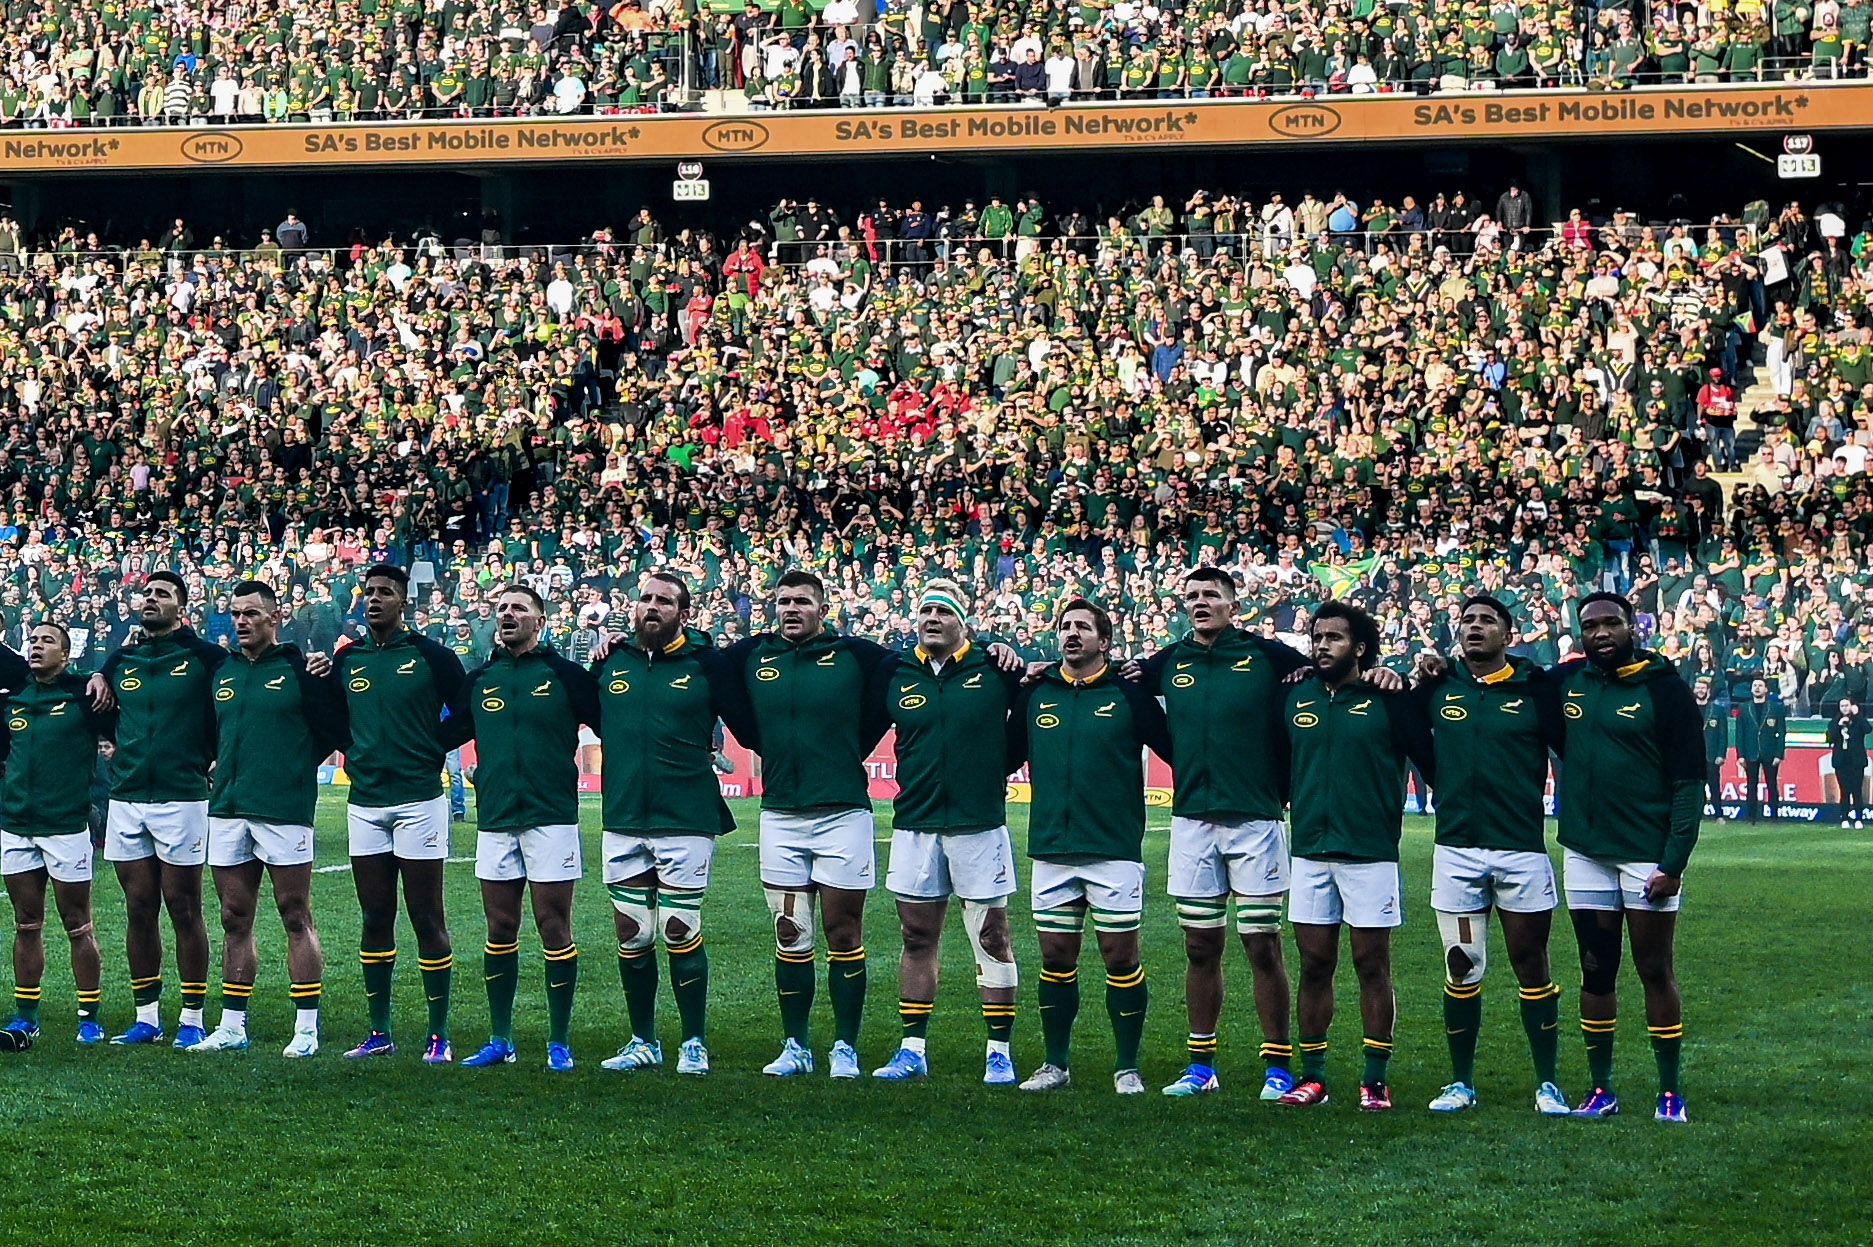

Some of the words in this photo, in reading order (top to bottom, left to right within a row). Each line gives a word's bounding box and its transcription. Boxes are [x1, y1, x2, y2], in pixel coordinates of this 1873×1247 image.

[1414, 104, 1476, 126] SA's
[1484, 102, 1551, 124] Best
[1558, 98, 1655, 122] Mobile
[835, 120, 893, 140] SA's
[900, 118, 960, 139] Best
[967, 116, 1057, 138] Mobile
[1285, 114, 1325, 128] MTN
[304, 133, 358, 153] SA's
[365, 132, 421, 152] Best
[428, 130, 510, 150] Mobile
[717, 129, 754, 143] MTN
[1787, 137, 1808, 149] 117
[194, 141, 229, 154] MTN
[1763, 804, 1819, 821] btway
